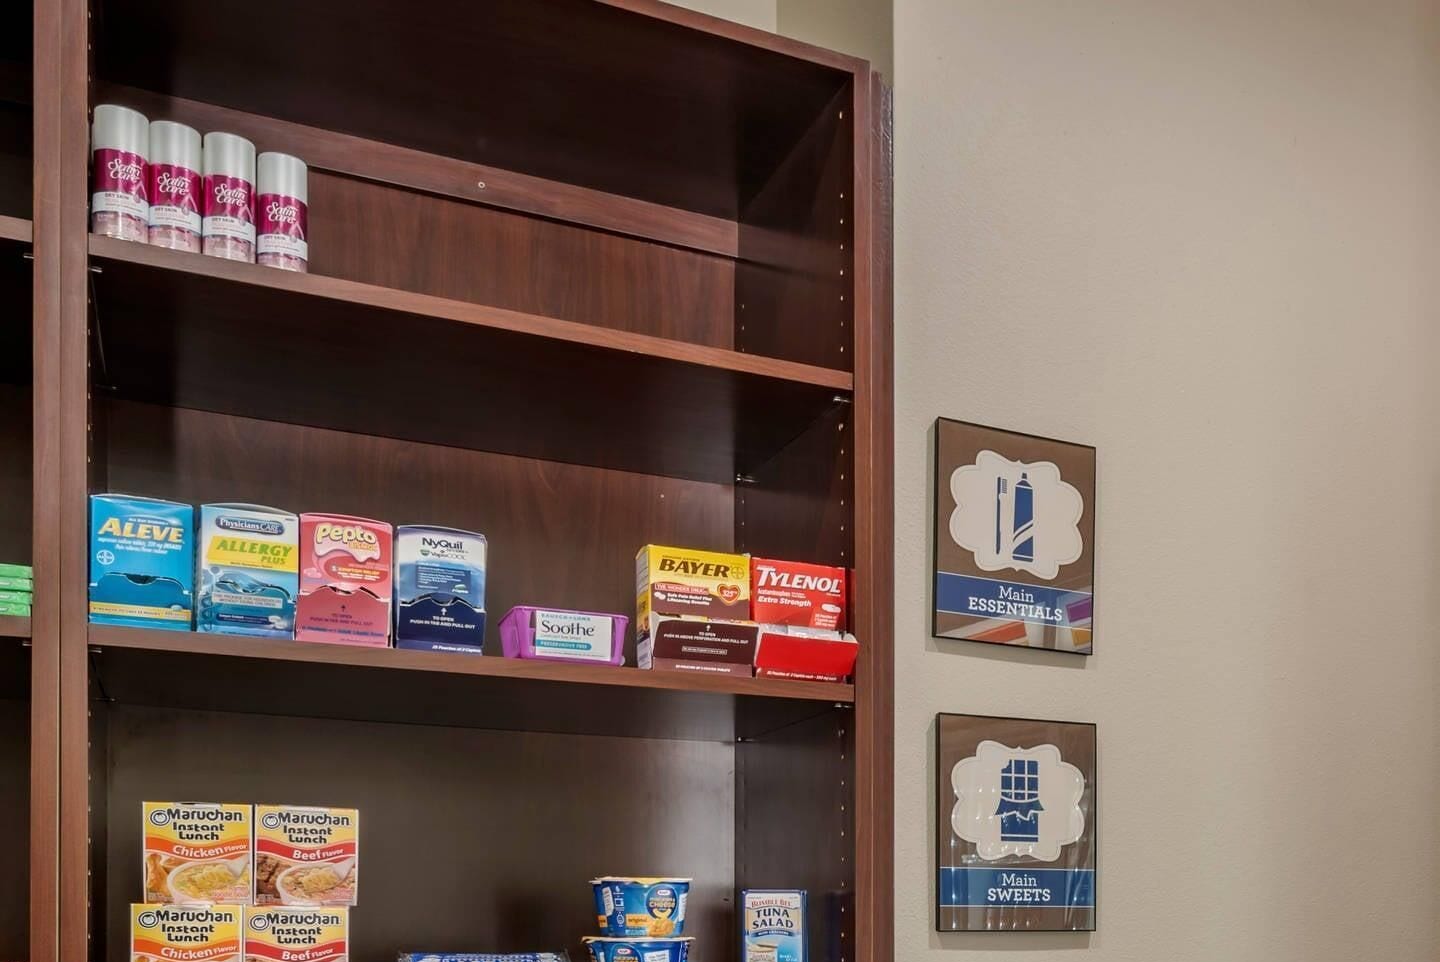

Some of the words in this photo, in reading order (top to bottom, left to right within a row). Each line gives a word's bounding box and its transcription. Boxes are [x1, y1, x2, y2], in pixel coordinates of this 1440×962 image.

[108, 158, 142, 178] Satin
[110, 167, 140, 182] Care
[157, 172, 191, 191] Satin
[159, 182, 189, 196] Care
[214, 183, 248, 202] Satin
[216, 193, 246, 207] Care
[266, 201, 298, 219] Satin
[268, 210, 297, 224] Care
[98, 517, 185, 544] ALEVE
[316, 524, 377, 545] Pepto
[216, 539, 293, 557] ALLERGY
[422, 537, 463, 550] NyQuil
[261, 556, 287, 565] PLUS
[659, 558, 730, 578] BAYER
[757, 566, 841, 593] TYLENOL
[999, 586, 1034, 603] Main
[757, 596, 778, 605] Extra
[780, 597, 811, 608] Strength
[968, 596, 1063, 621] ESSENTIALS
[541, 620, 595, 636] Soothe
[167, 809, 242, 822] Maruchan
[278, 812, 350, 826] Maruchan
[173, 822, 224, 831] Instant
[283, 825, 332, 835] Instant
[179, 832, 220, 841] Lunch
[288, 835, 327, 844] Lunch
[172, 845, 224, 858] Chicken
[224, 844, 248, 852] Flavor
[293, 849, 321, 860] Beef
[322, 849, 343, 857] Flavor
[1002, 873, 1037, 886] Main
[987, 888, 1051, 901] SWEETS
[156, 910, 233, 922] Maruchan
[267, 913, 340, 925] Maruchan
[756, 908, 789, 918] TUNA
[161, 924, 214, 933] Instant
[272, 926, 322, 935] Instant
[752, 919, 794, 929] SALAD
[168, 933, 209, 942] Lunch
[277, 936, 316, 944] Lunch
[161, 948, 212, 959] Chicken
[213, 946, 237, 954] Flavor
[282, 951, 311, 961] Beef
[311, 949, 333, 957] Flavor
